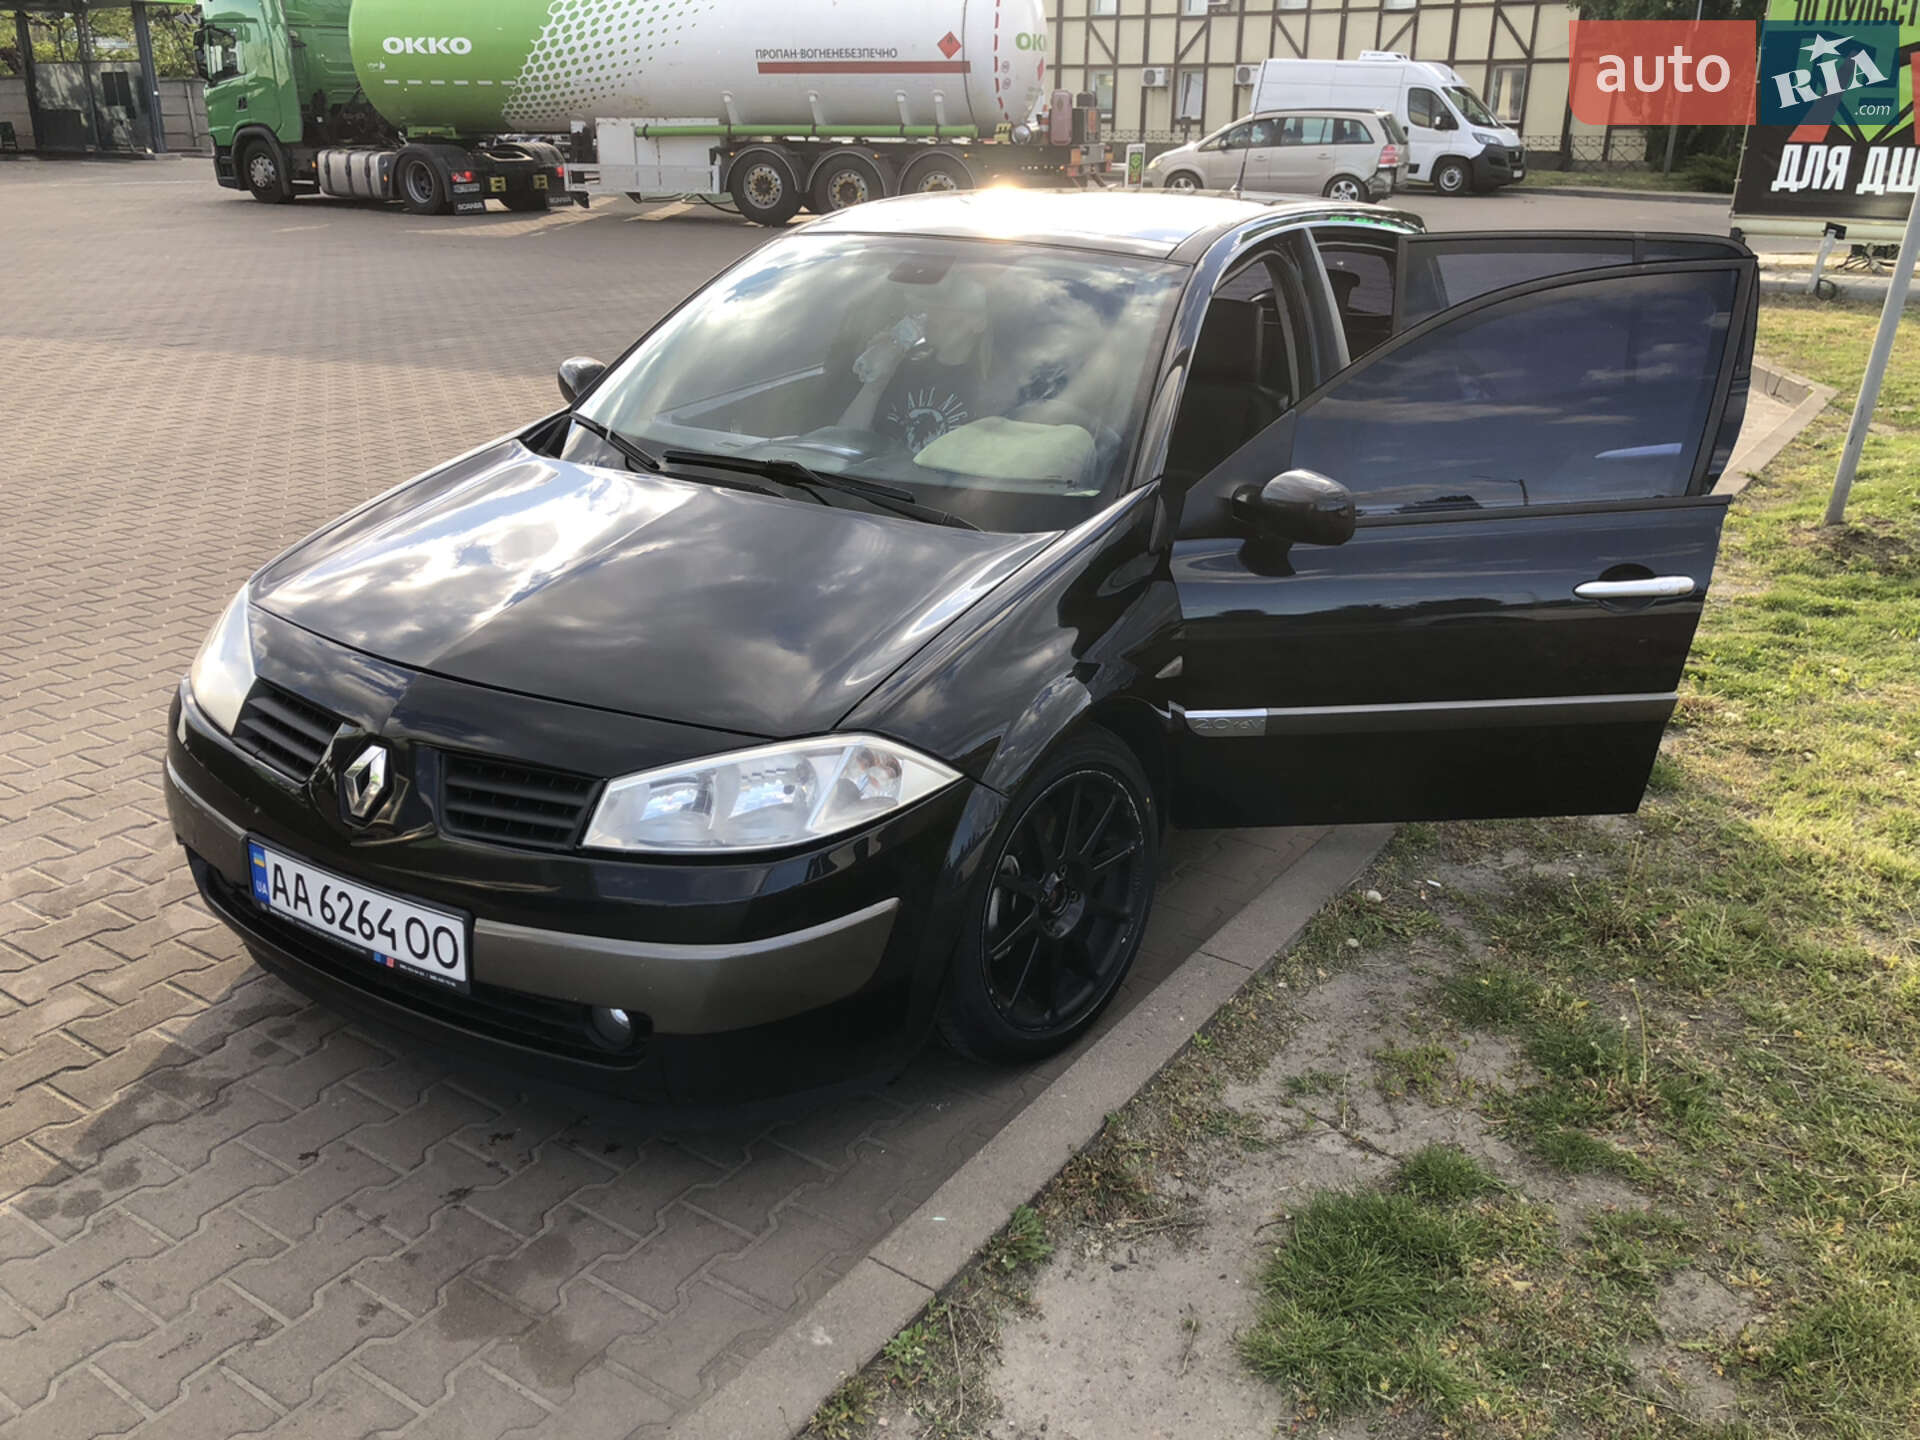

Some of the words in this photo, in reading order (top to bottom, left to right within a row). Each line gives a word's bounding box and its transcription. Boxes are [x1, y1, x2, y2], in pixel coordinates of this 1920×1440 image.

[382, 37, 472, 54] OKKO
[755, 48, 898, 59] ПРОПАН-ВОГНЕНЕБЕЗПЕЧНО
[1770, 144, 1852, 193] ДЛЯ
[256, 881, 268, 895] UA
[272, 863, 313, 917] AA
[320, 884, 397, 951] 6264
